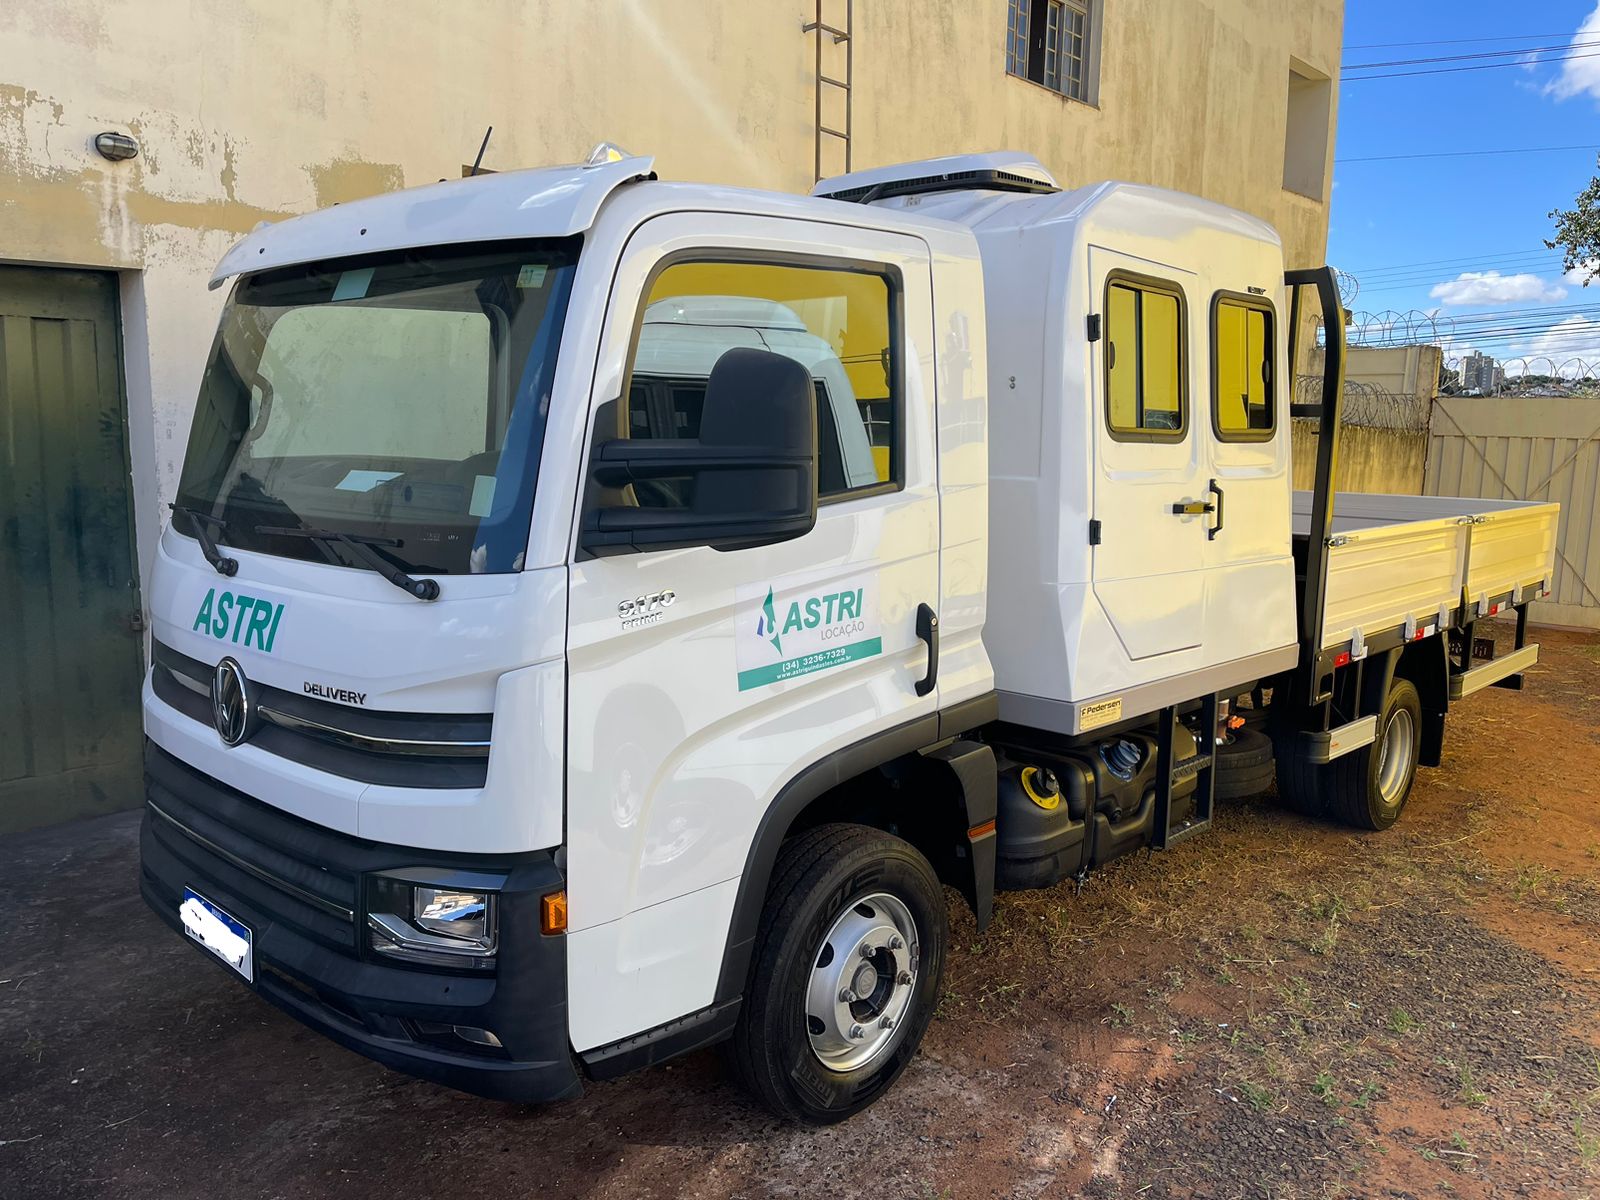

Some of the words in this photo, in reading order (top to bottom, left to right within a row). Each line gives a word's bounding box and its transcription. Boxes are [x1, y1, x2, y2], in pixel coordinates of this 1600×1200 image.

[192, 588, 285, 653] ASTRI
[622, 611, 664, 630] PRIME
[782, 588, 863, 635] ASTRI
[821, 620, 865, 641] LOCAÇÃO
[776, 655, 852, 679] www.astriguindastes.com.br
[782, 660, 799, 672] (34)
[803, 648, 846, 666] 3236-7329
[303, 681, 367, 705] DELIVERY
[1087, 700, 1121, 715] Pedersen
